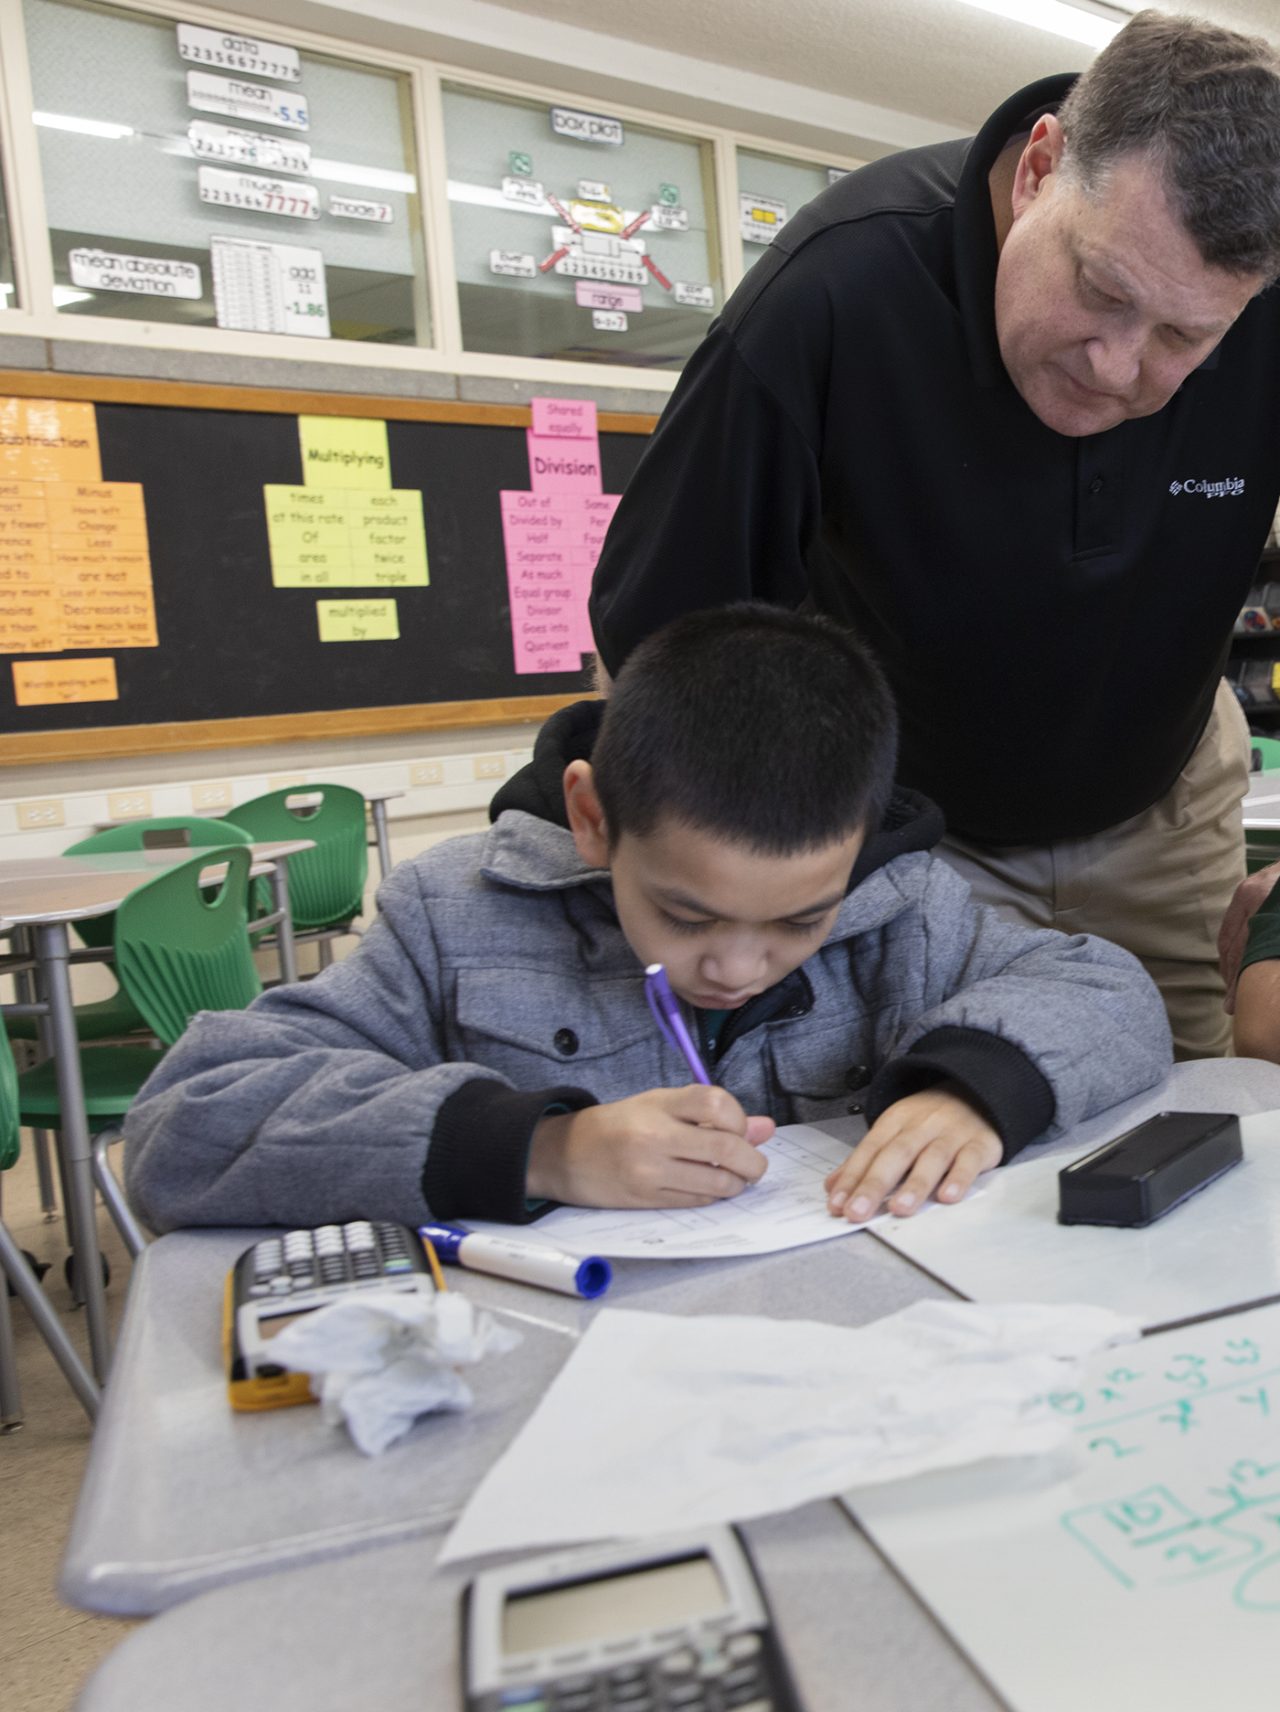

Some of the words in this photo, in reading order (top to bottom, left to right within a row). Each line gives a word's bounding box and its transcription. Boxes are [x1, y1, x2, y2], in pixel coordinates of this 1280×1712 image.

[554, 113, 586, 131] box
[589, 121, 620, 139] plot
[73, 252, 122, 271] mean
[126, 256, 195, 279] absolute
[101, 272, 175, 294] deviation
[308, 449, 384, 469] Multiplying
[534, 456, 597, 476] Division
[1183, 476, 1245, 494] Columbia
